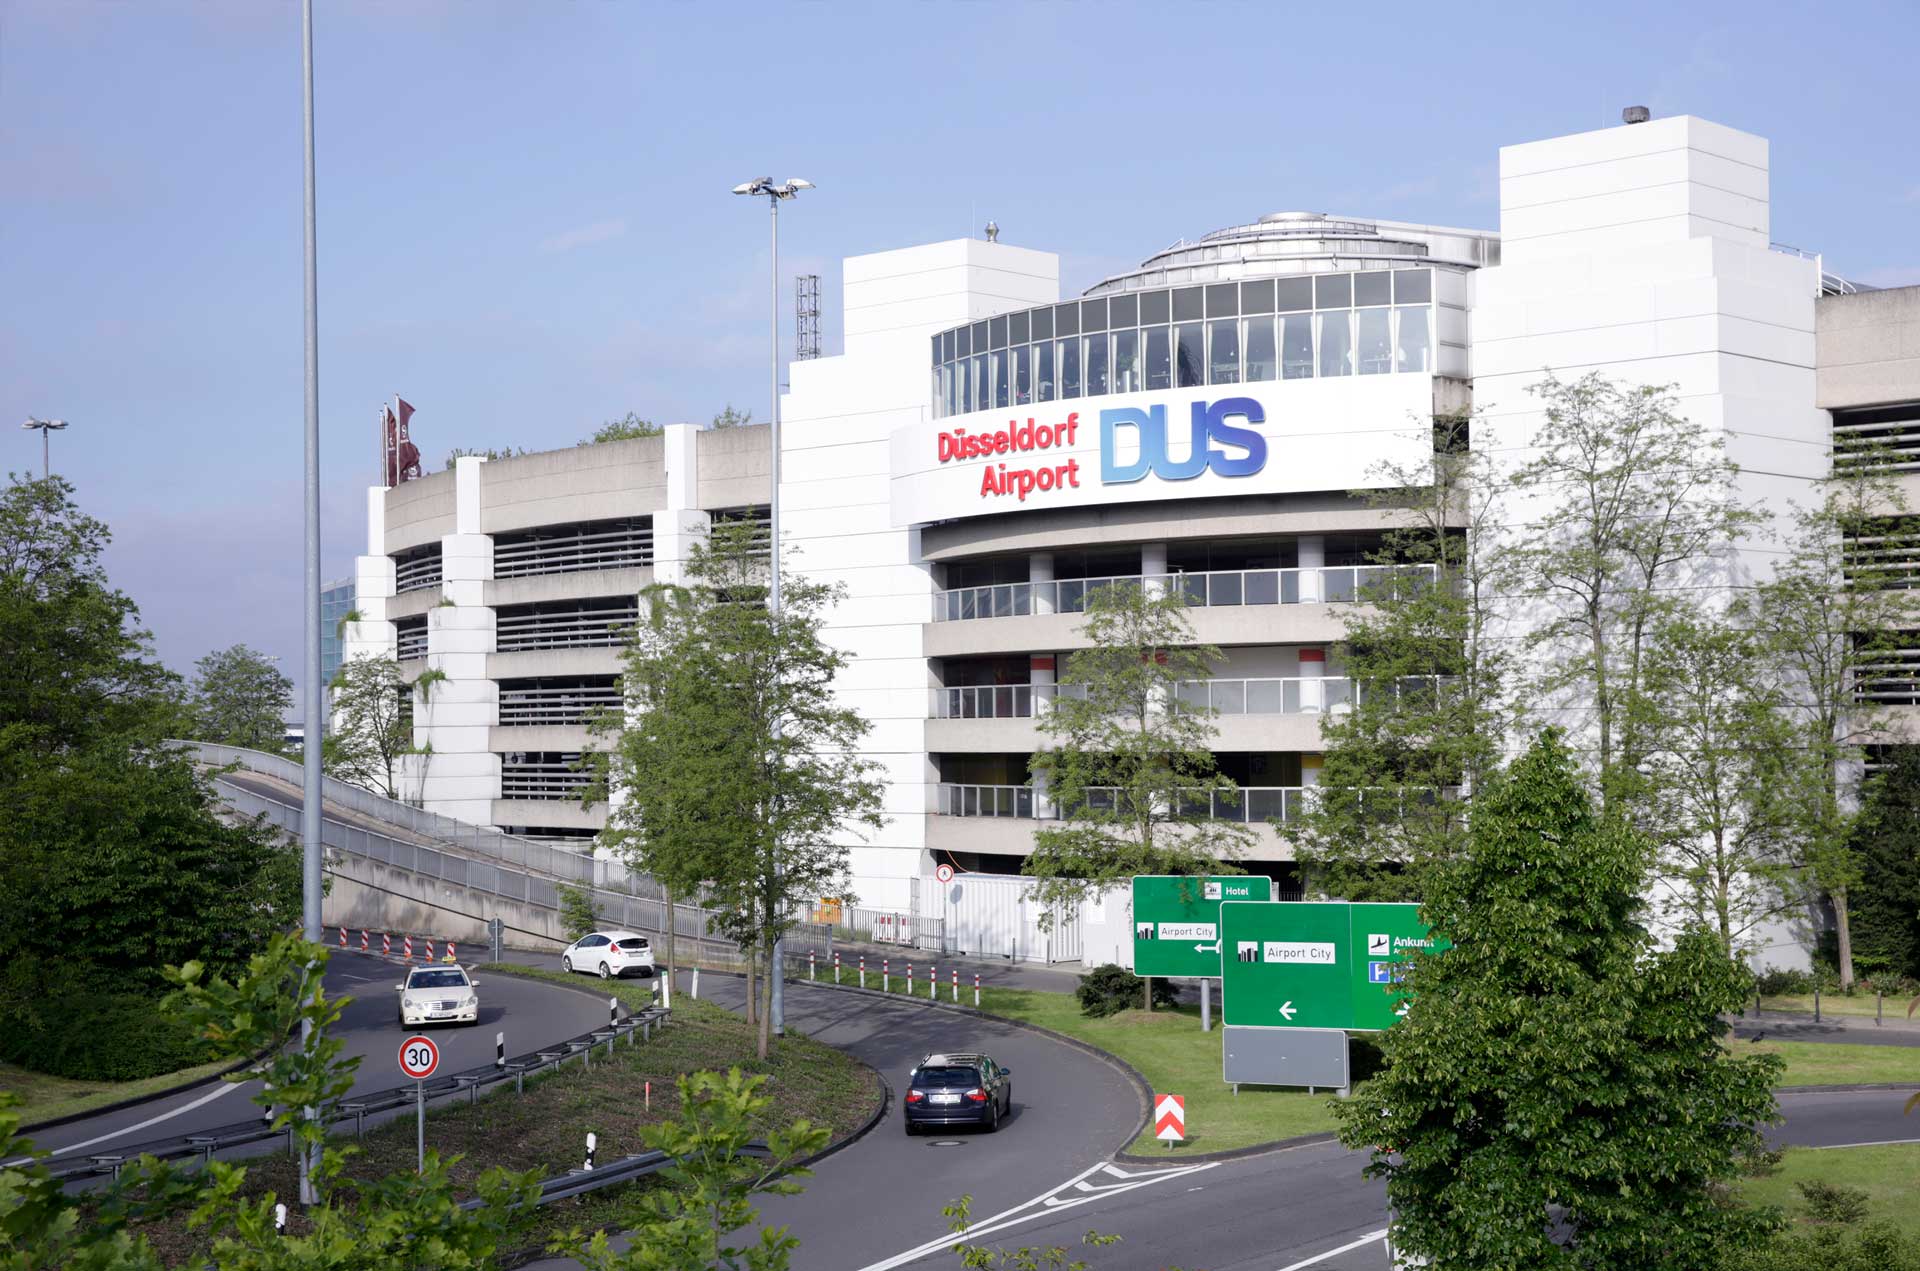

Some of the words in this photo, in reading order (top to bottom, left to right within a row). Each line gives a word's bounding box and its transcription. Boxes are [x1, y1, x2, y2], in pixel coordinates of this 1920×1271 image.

[938, 412, 1079, 463] Düsseldorf
[1099, 396, 1268, 484] DUS
[980, 458, 1080, 500] Airport
[1225, 886, 1249, 896] Hotel
[1161, 927, 1192, 937] Airport
[1196, 927, 1213, 938] City
[1268, 947, 1305, 960] Airport
[1310, 947, 1331, 961] City
[408, 1048, 430, 1066] 30
